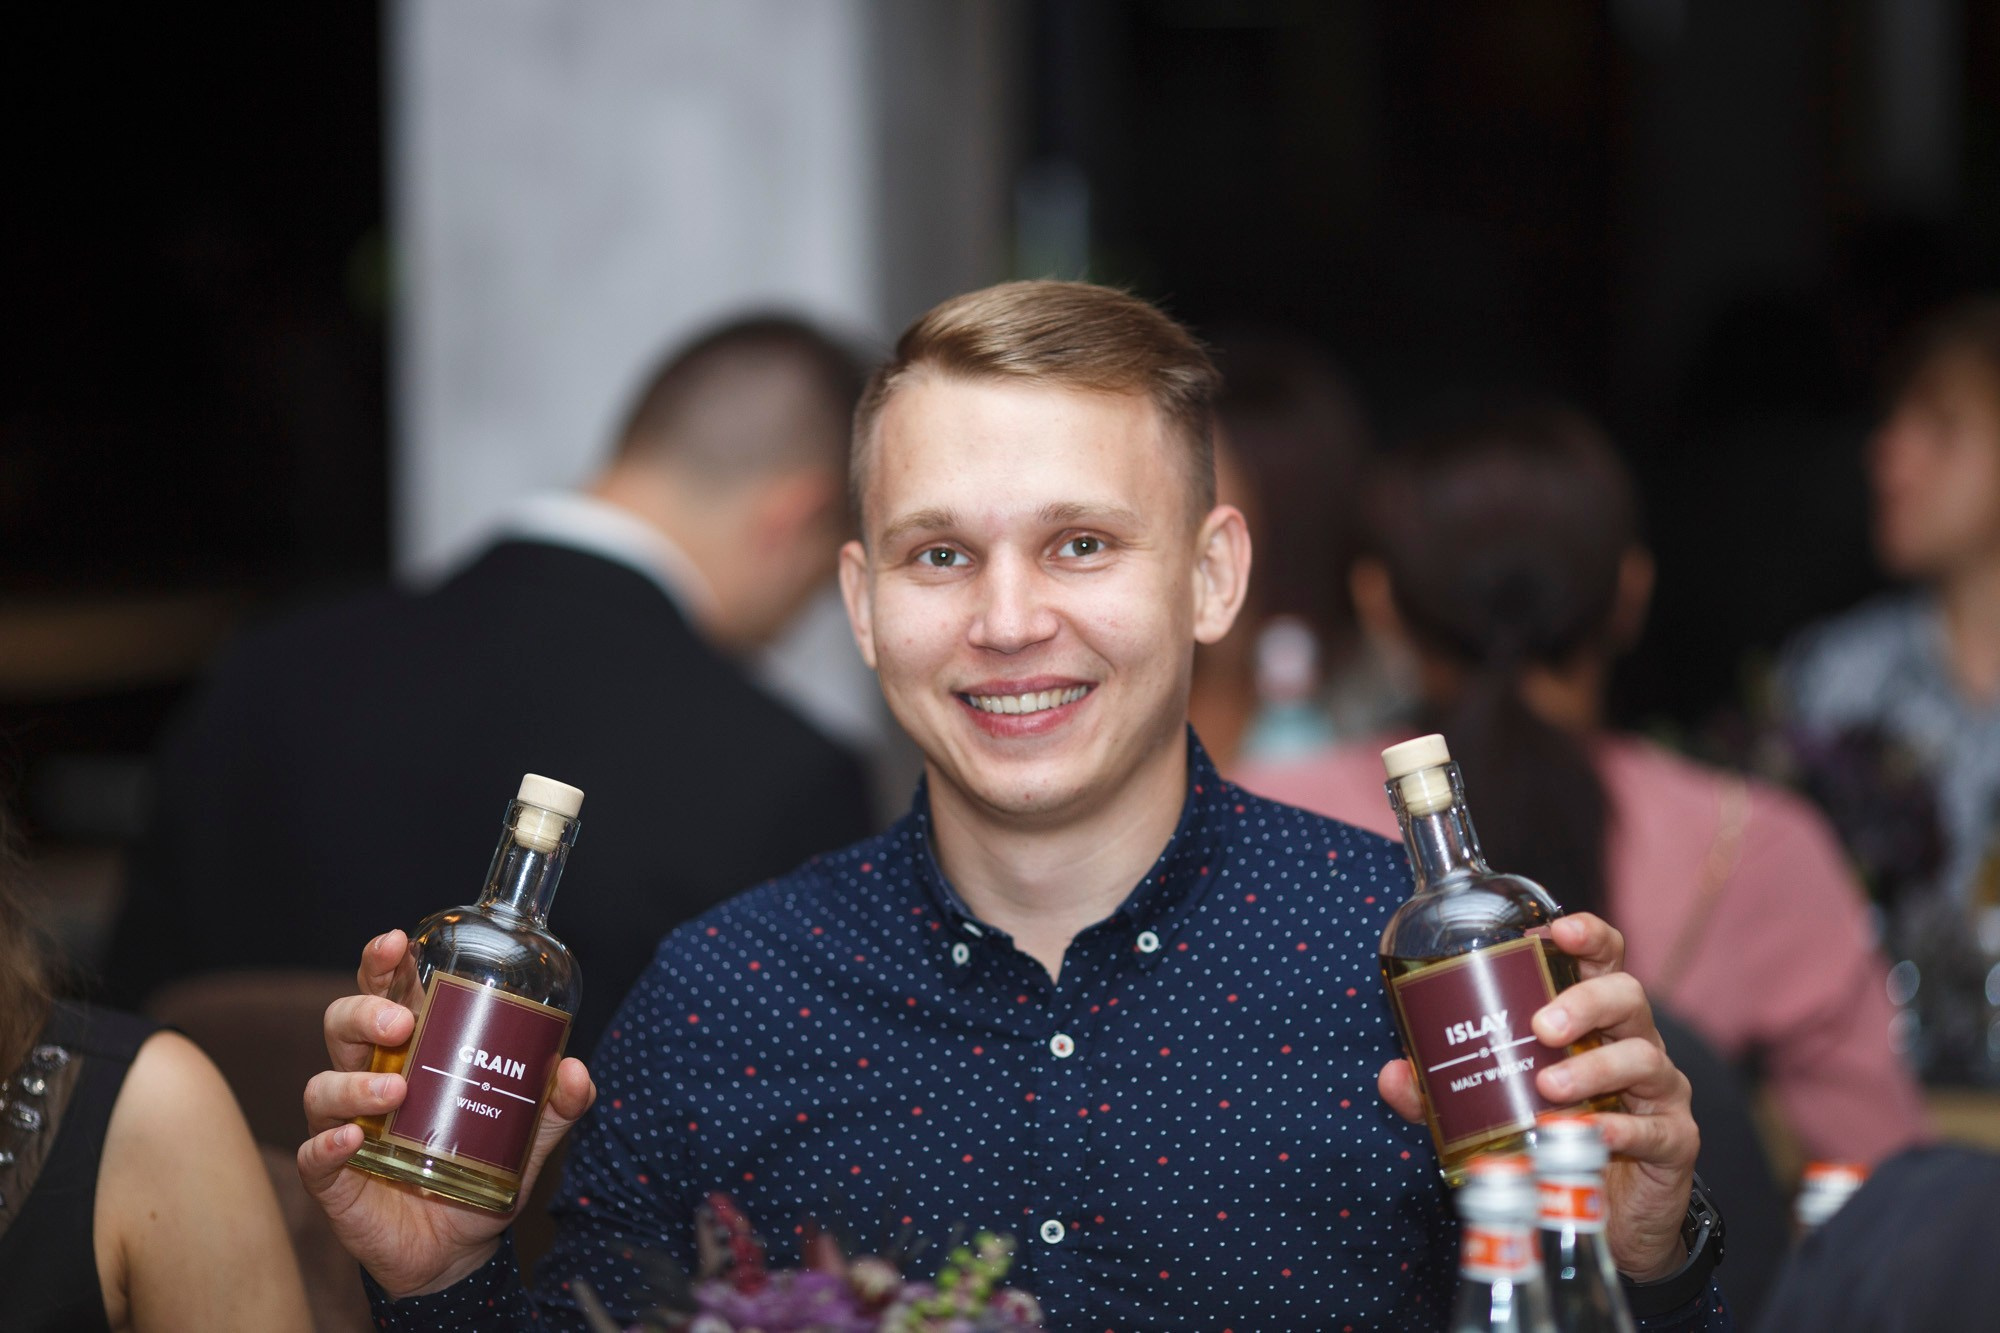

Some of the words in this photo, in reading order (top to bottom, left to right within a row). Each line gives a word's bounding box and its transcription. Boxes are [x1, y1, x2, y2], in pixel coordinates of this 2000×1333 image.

[1444, 1009, 1508, 1046] ISLAY
[458, 1045, 527, 1080] GRAIN
[1450, 1073, 1483, 1093] MALT
[1483, 1056, 1535, 1082] WHISKY
[456, 1096, 503, 1120] WHISKY
